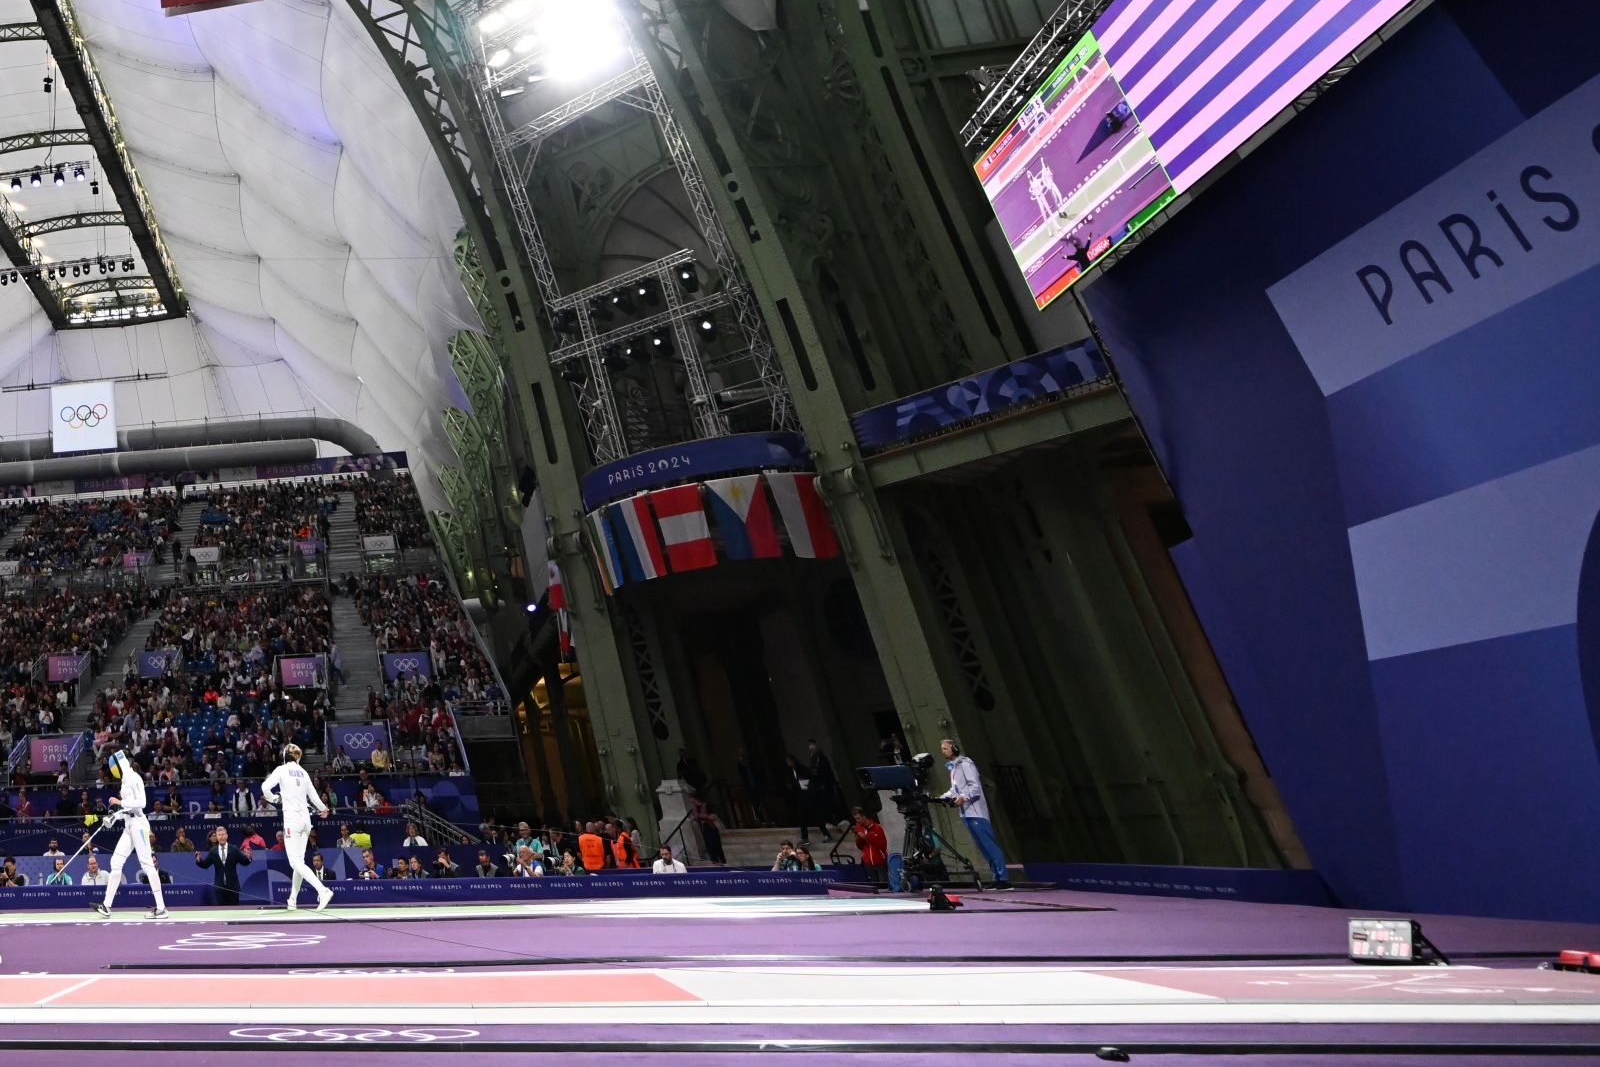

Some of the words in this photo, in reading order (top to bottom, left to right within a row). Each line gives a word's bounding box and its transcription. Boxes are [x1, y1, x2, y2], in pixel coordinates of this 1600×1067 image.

[1091, 236, 1109, 258] OMEGA
[296, 463, 322, 472] 2024
[648, 455, 691, 473] 2024
[42, 745, 68, 753] PARIS
[43, 754, 68, 763] 2024
